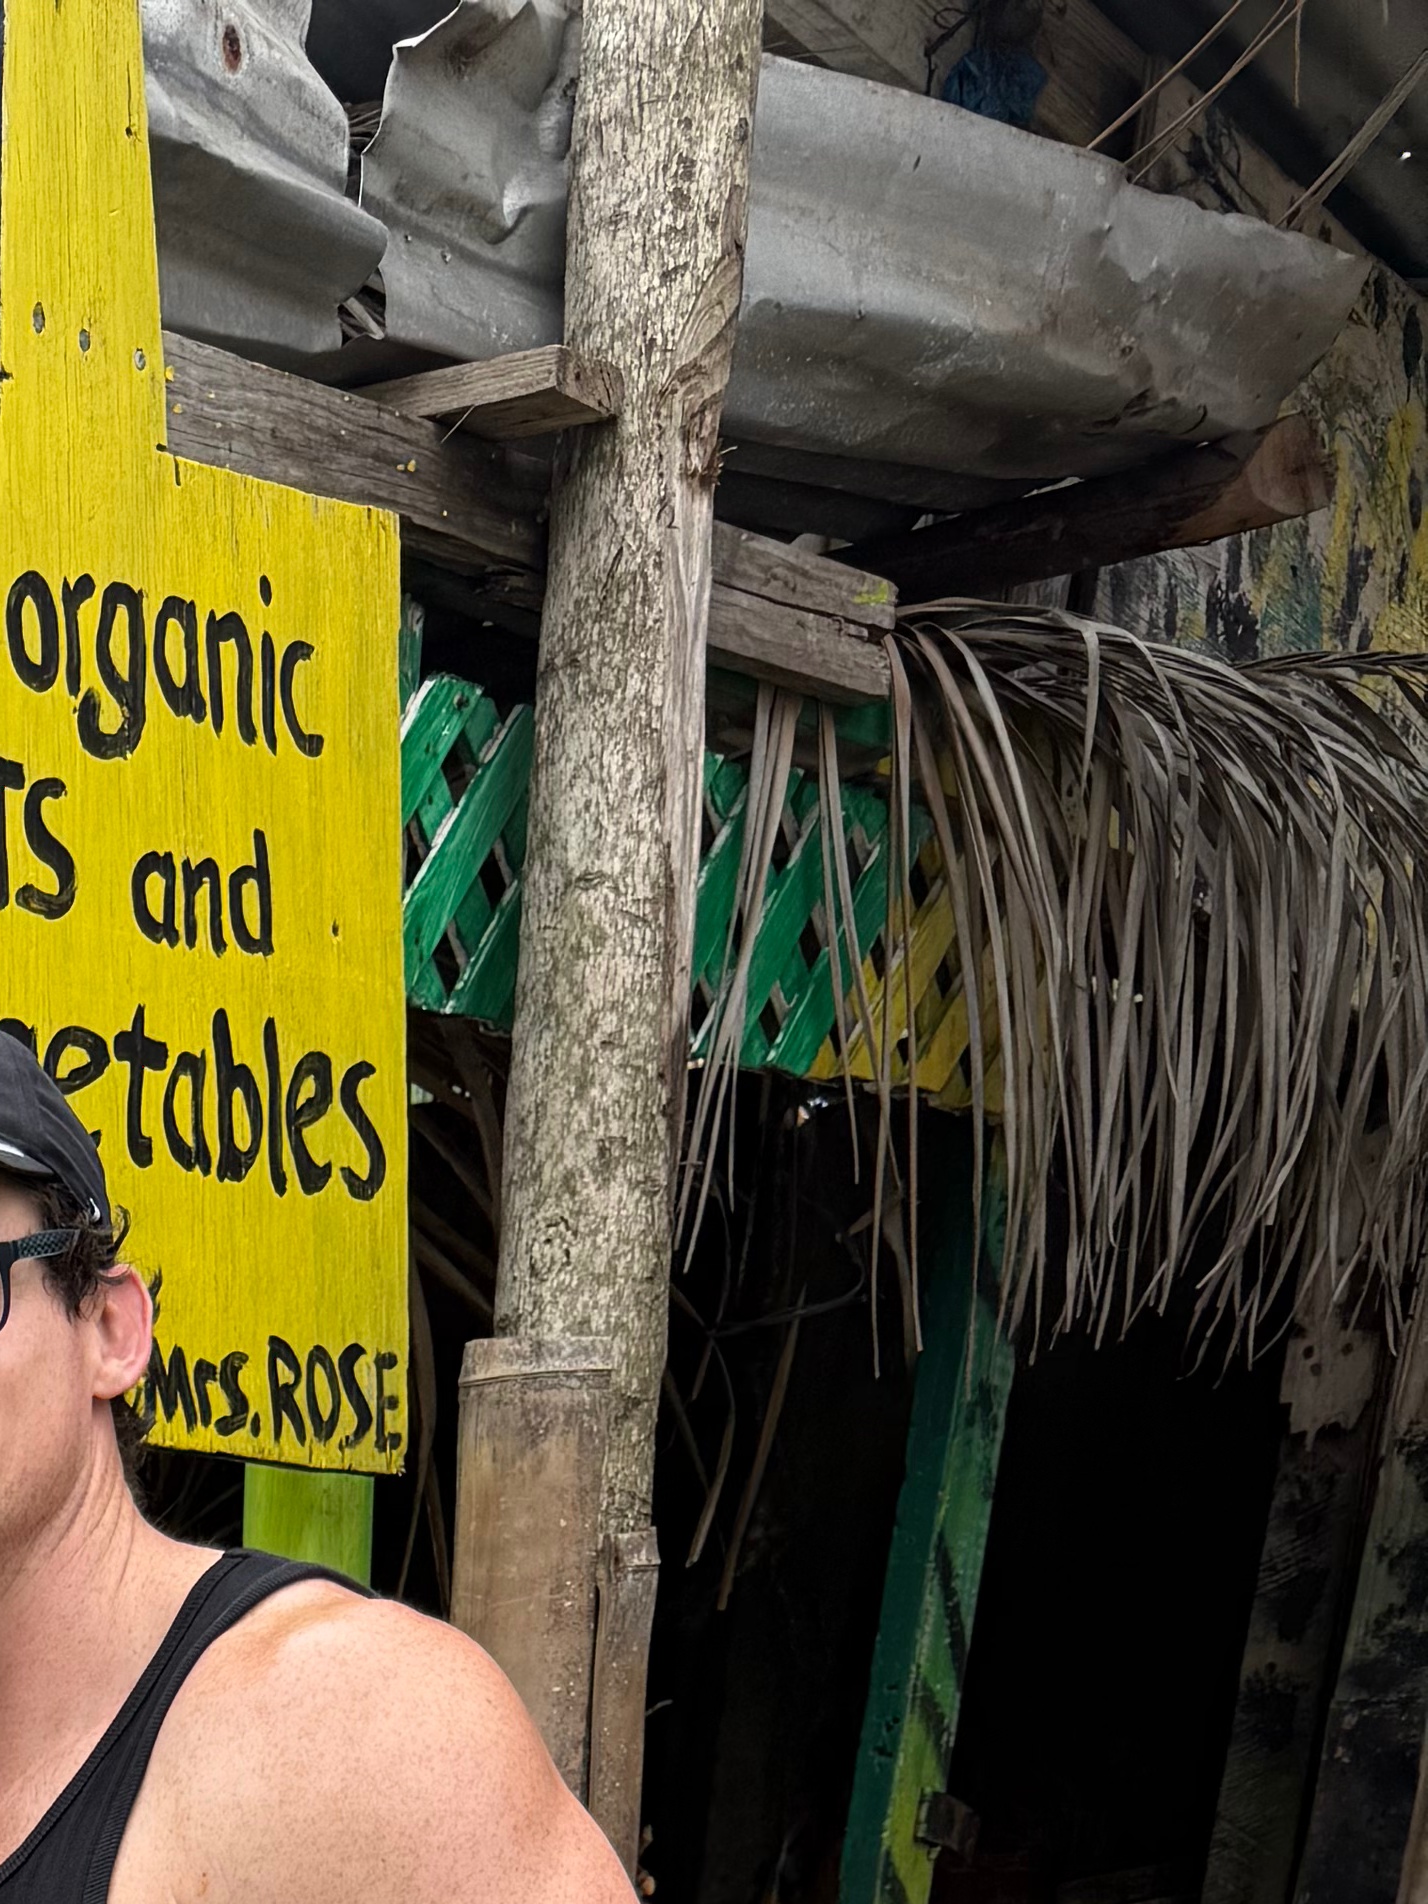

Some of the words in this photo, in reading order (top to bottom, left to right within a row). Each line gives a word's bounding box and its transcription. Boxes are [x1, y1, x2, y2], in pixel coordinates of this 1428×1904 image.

[5, 571, 324, 761] organic
[131, 828, 275, 958] and
[267, 1335, 402, 1455] ROSE
